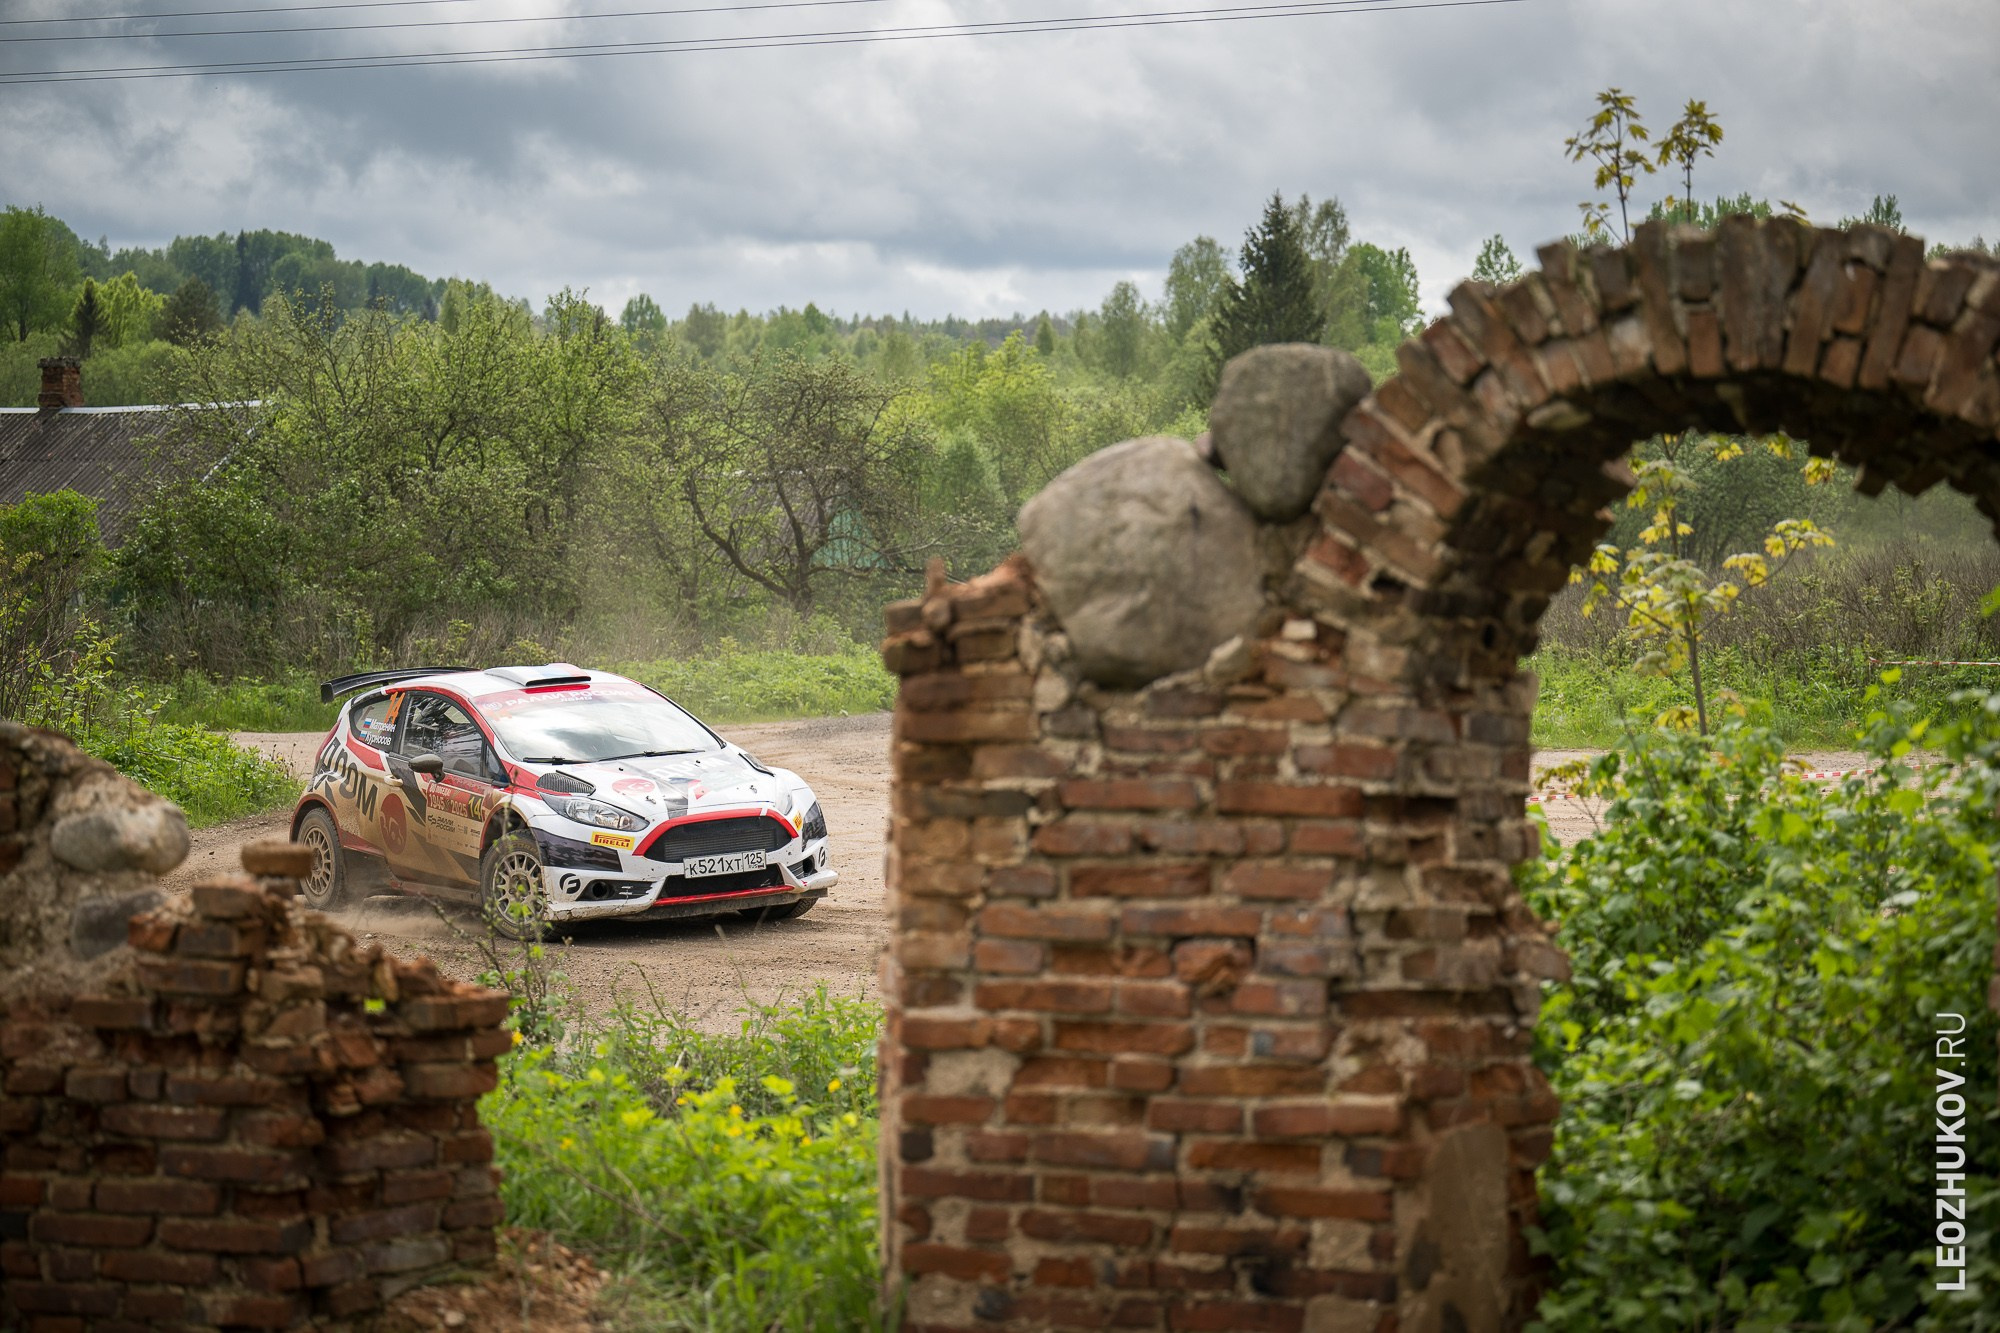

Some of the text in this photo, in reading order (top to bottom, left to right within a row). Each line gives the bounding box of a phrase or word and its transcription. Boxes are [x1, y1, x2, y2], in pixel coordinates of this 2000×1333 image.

[505, 691, 564, 707] РАЛЛИ
[568, 689, 634, 698] РОССИИ
[384, 691, 405, 725] 14
[364, 731, 392, 746] Курносов
[429, 793, 468, 818] 1945 2025
[468, 796, 482, 820] 14
[594, 834, 630, 848] PIRELLI
[744, 852, 763, 865] 125
